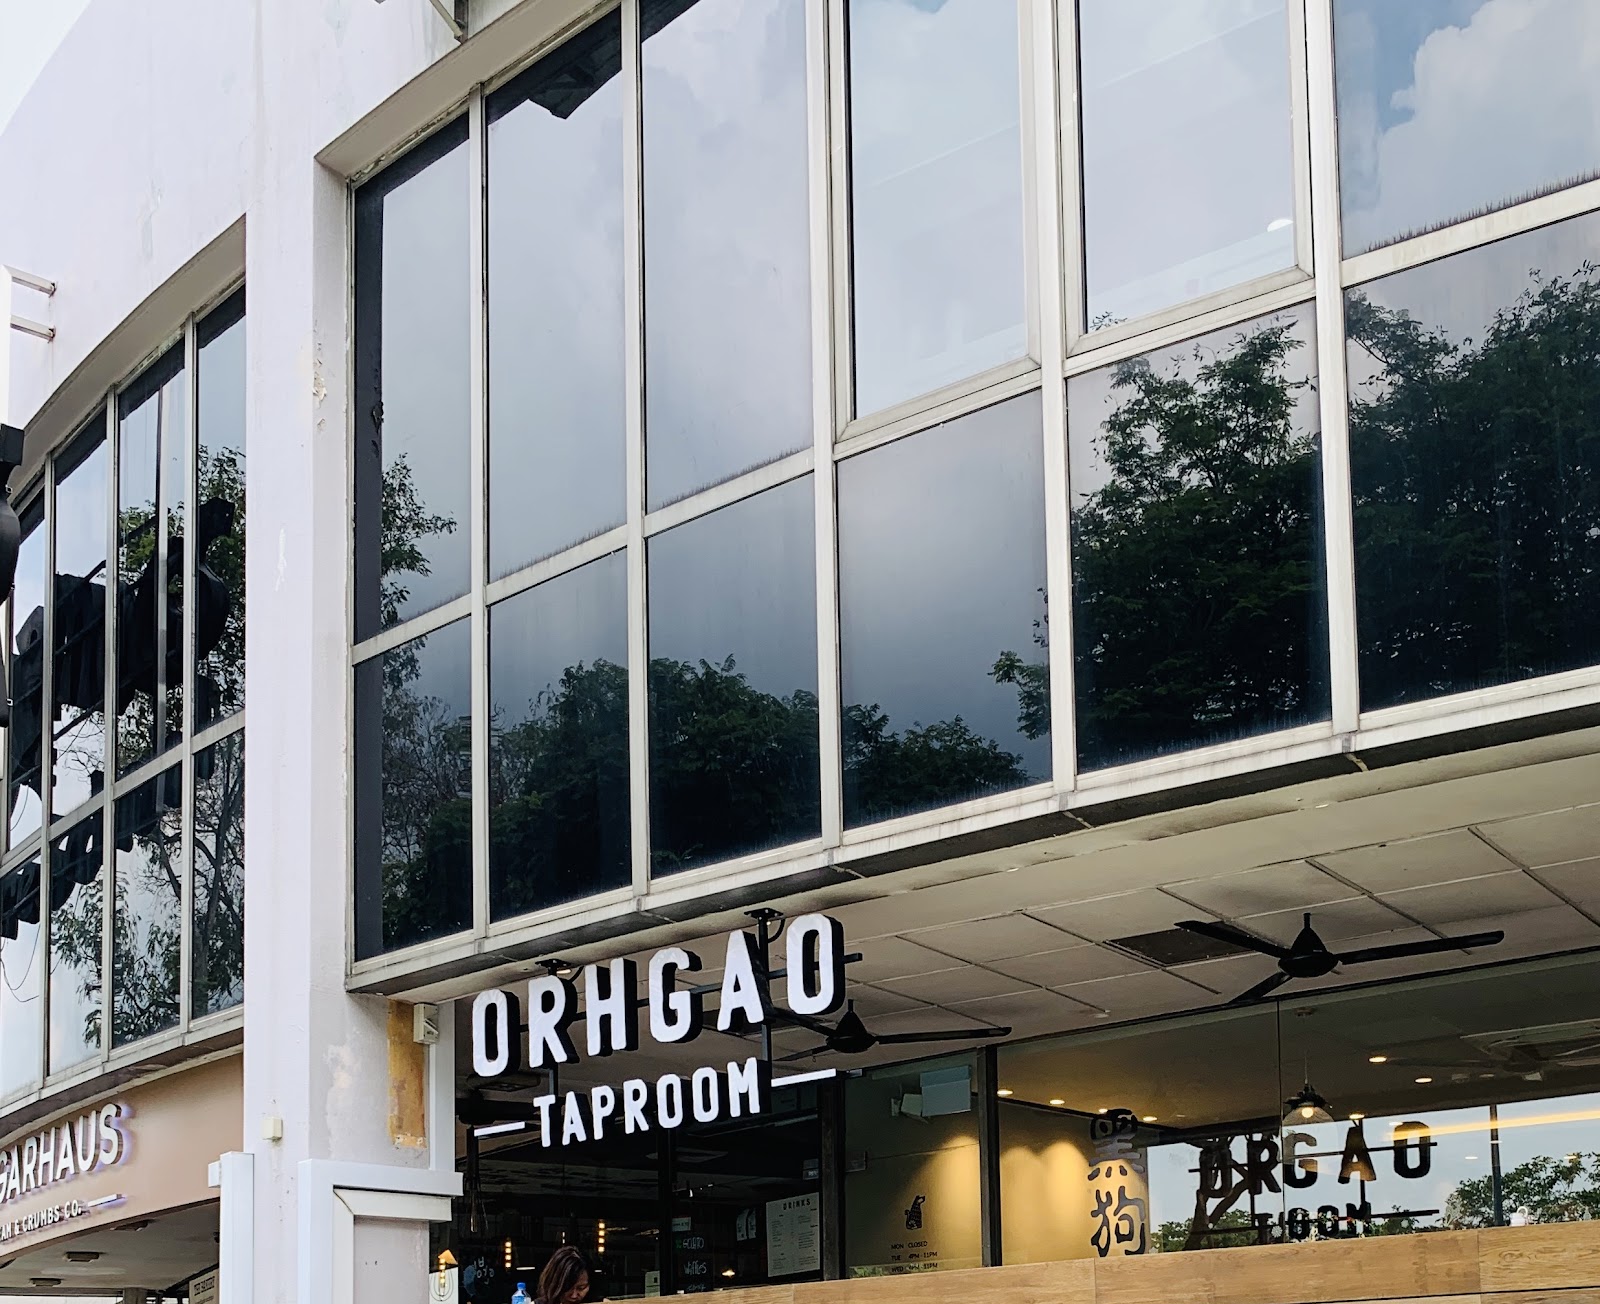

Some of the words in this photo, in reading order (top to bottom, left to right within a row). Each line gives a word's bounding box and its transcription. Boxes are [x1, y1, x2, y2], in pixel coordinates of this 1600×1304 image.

[472, 914, 834, 1077] ORHGAO
[532, 1056, 761, 1147] TAPROOM
[22, 1204, 61, 1232] CRUMBS
[64, 1199, 82, 1218] CO.
[783, 1198, 810, 1211] DRINKS
[908, 1240, 928, 1249] CLOSED
